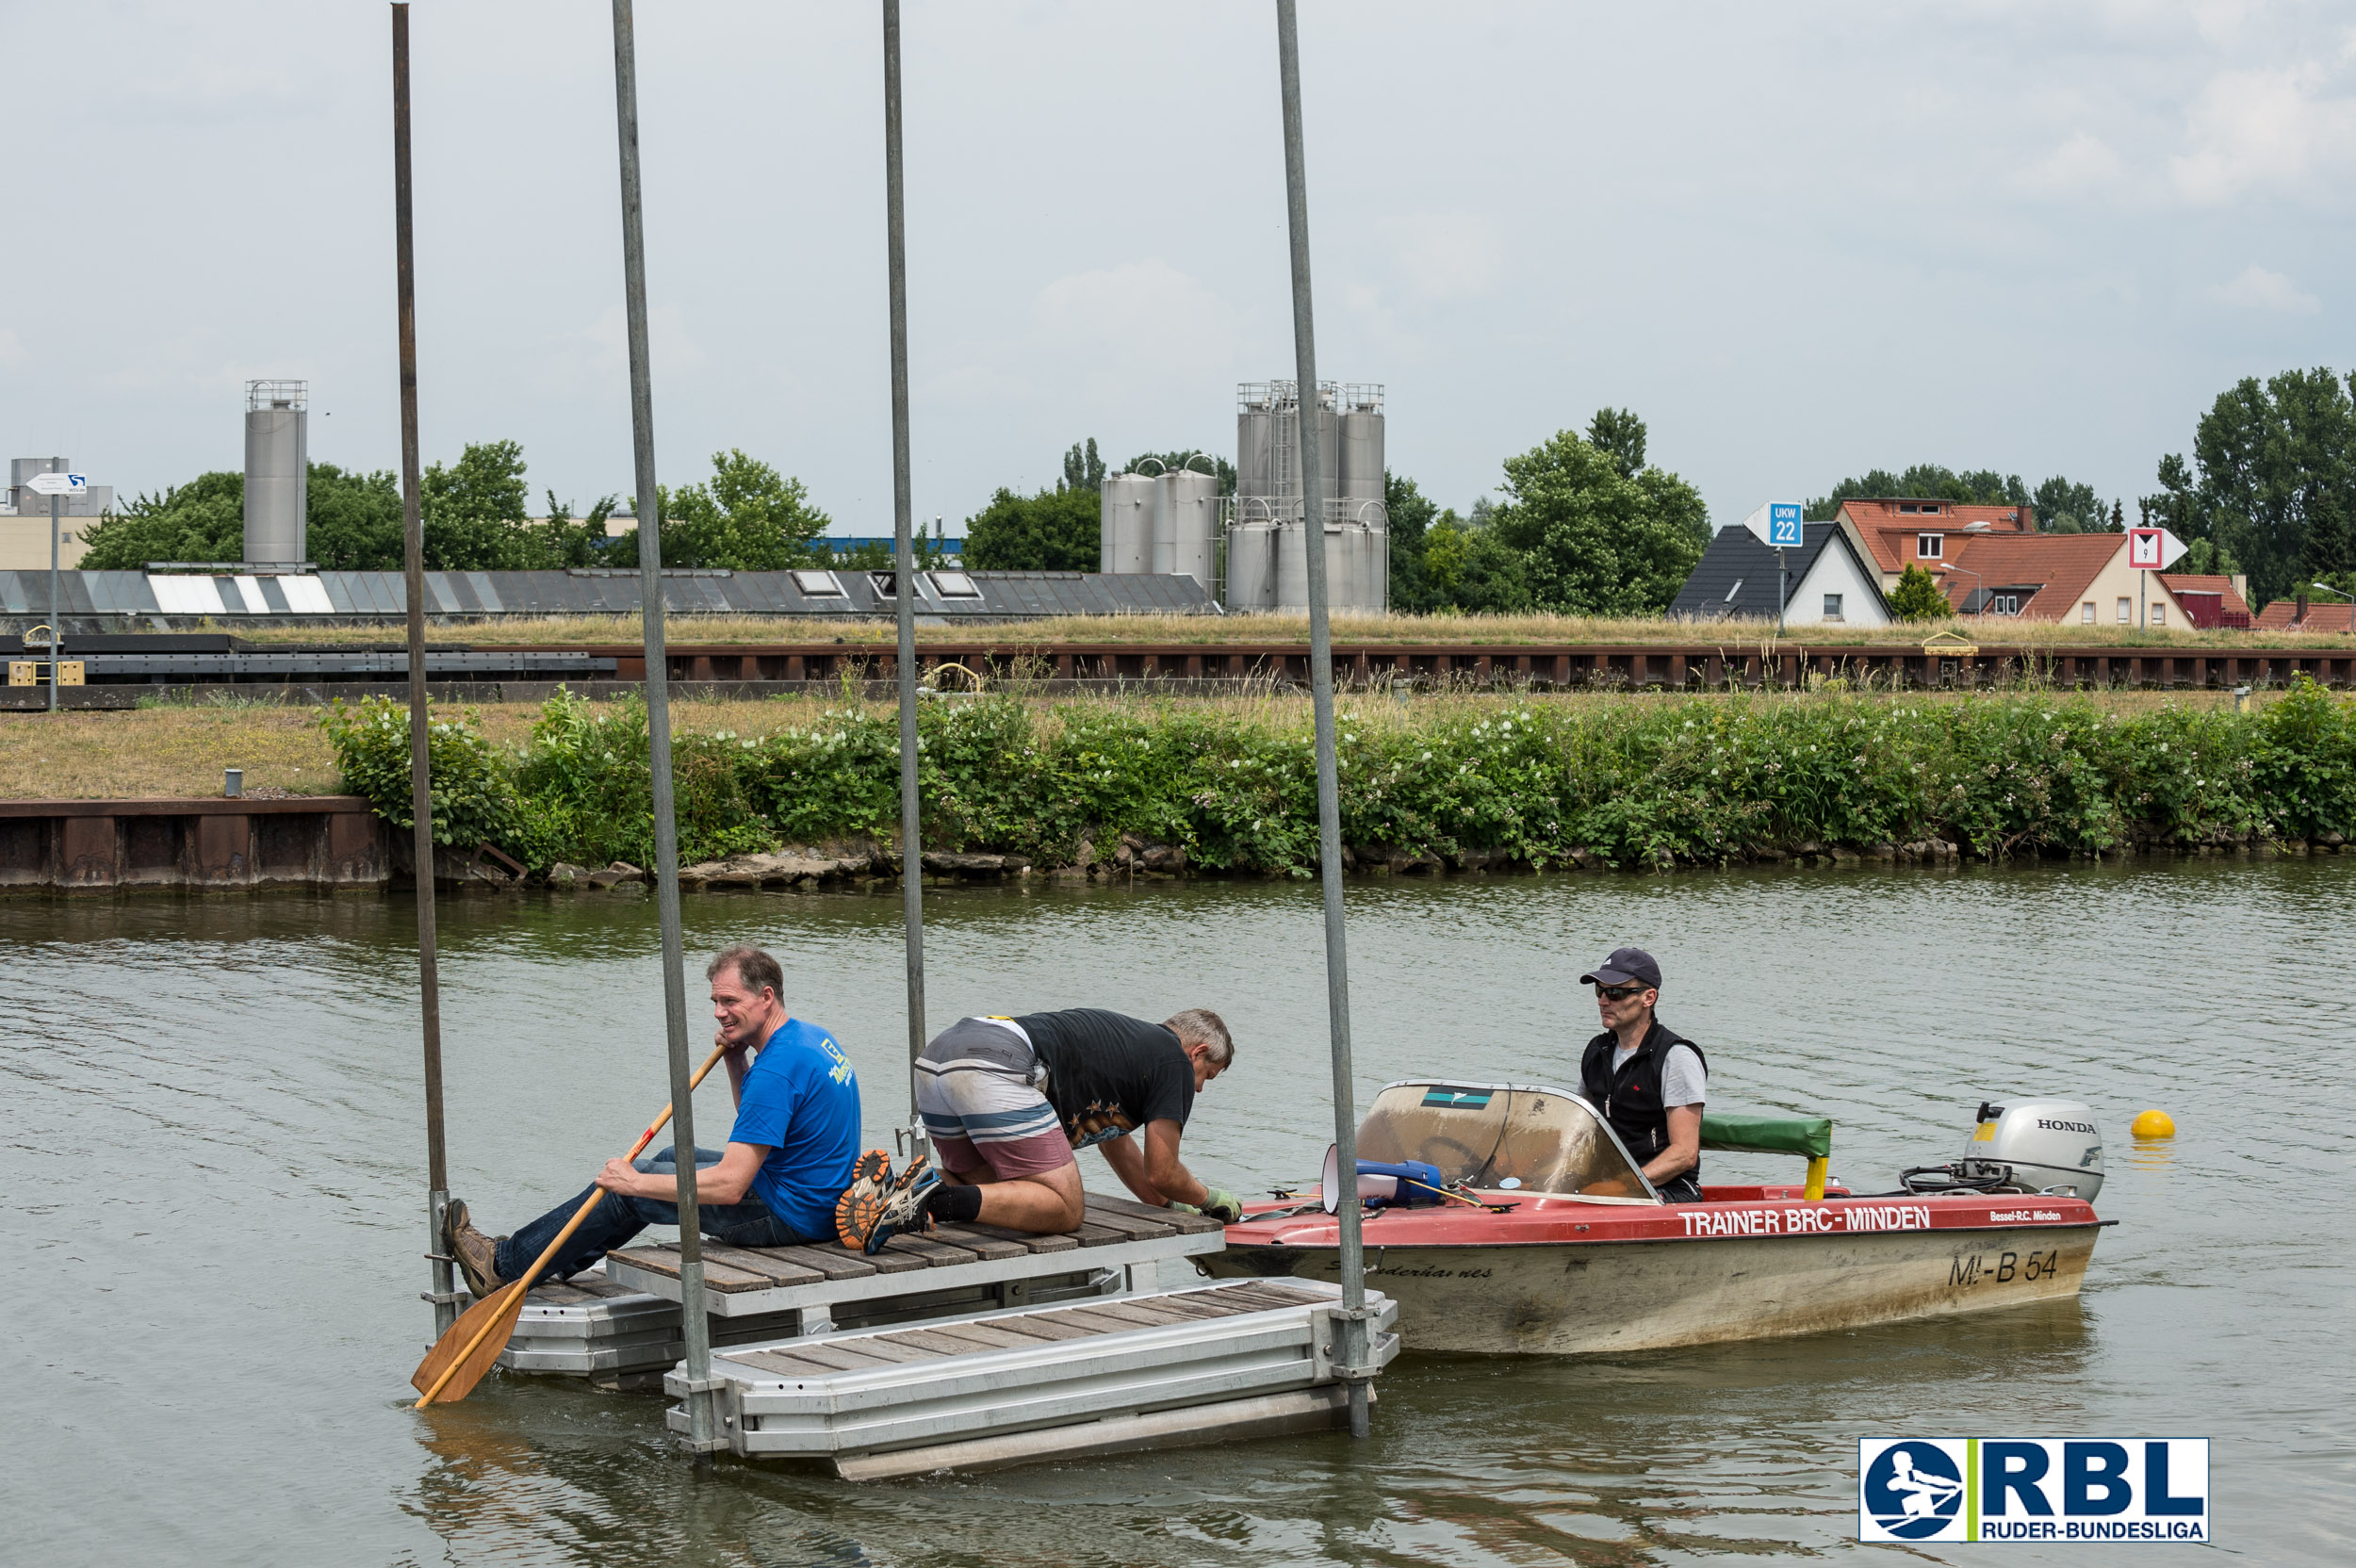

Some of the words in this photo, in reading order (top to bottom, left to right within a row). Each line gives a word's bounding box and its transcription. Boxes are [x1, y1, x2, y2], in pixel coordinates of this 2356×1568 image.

[1775, 507, 1796, 518] UKW
[1775, 520, 1795, 541] 22
[2143, 548, 2149, 559] 9
[2037, 1119, 2097, 1135] HONDA
[1677, 1210, 1780, 1235] TRAINER
[2033, 1210, 2061, 1221] Minden
[2024, 1250, 2058, 1282] 54
